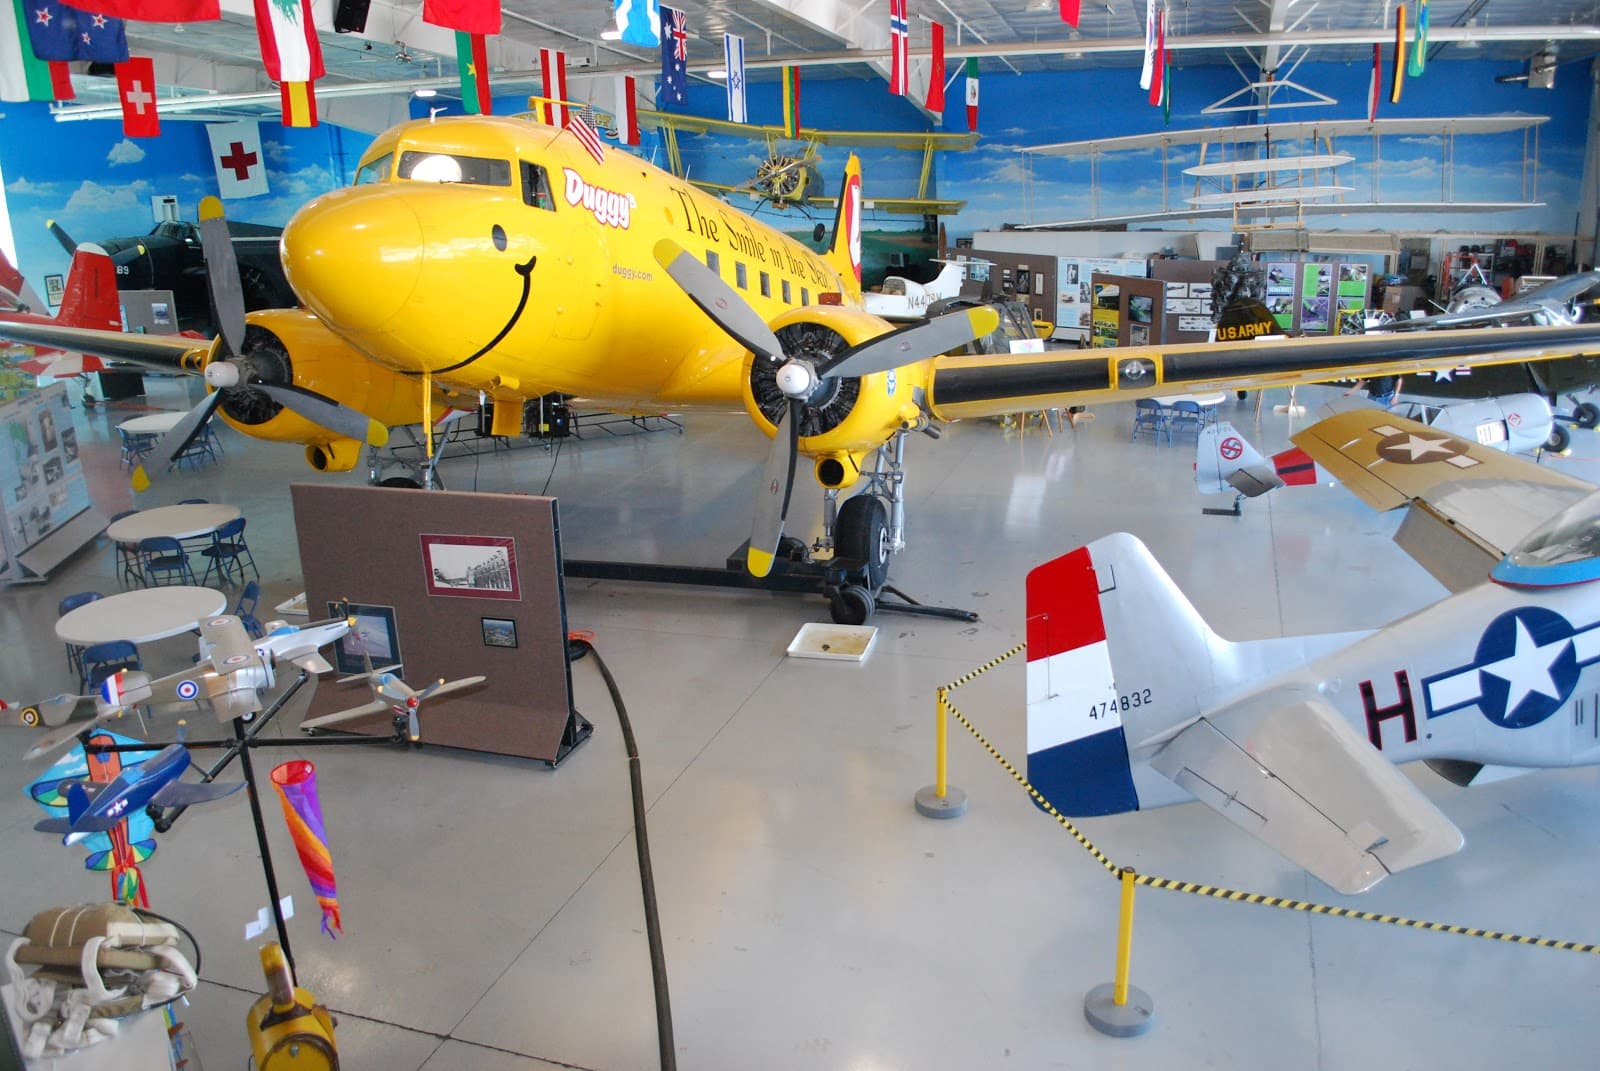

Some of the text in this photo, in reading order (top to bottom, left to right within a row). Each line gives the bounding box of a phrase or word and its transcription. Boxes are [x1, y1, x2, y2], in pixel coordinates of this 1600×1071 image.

[562, 166, 632, 230] Duggy
[670, 186, 720, 242] The
[718, 209, 766, 263] Smile
[781, 239, 806, 279] the
[612, 263, 653, 281] duggy.com
[1238, 320, 1272, 338] ARMY
[1089, 688, 1152, 720] 474832
[1358, 669, 1418, 751] H
